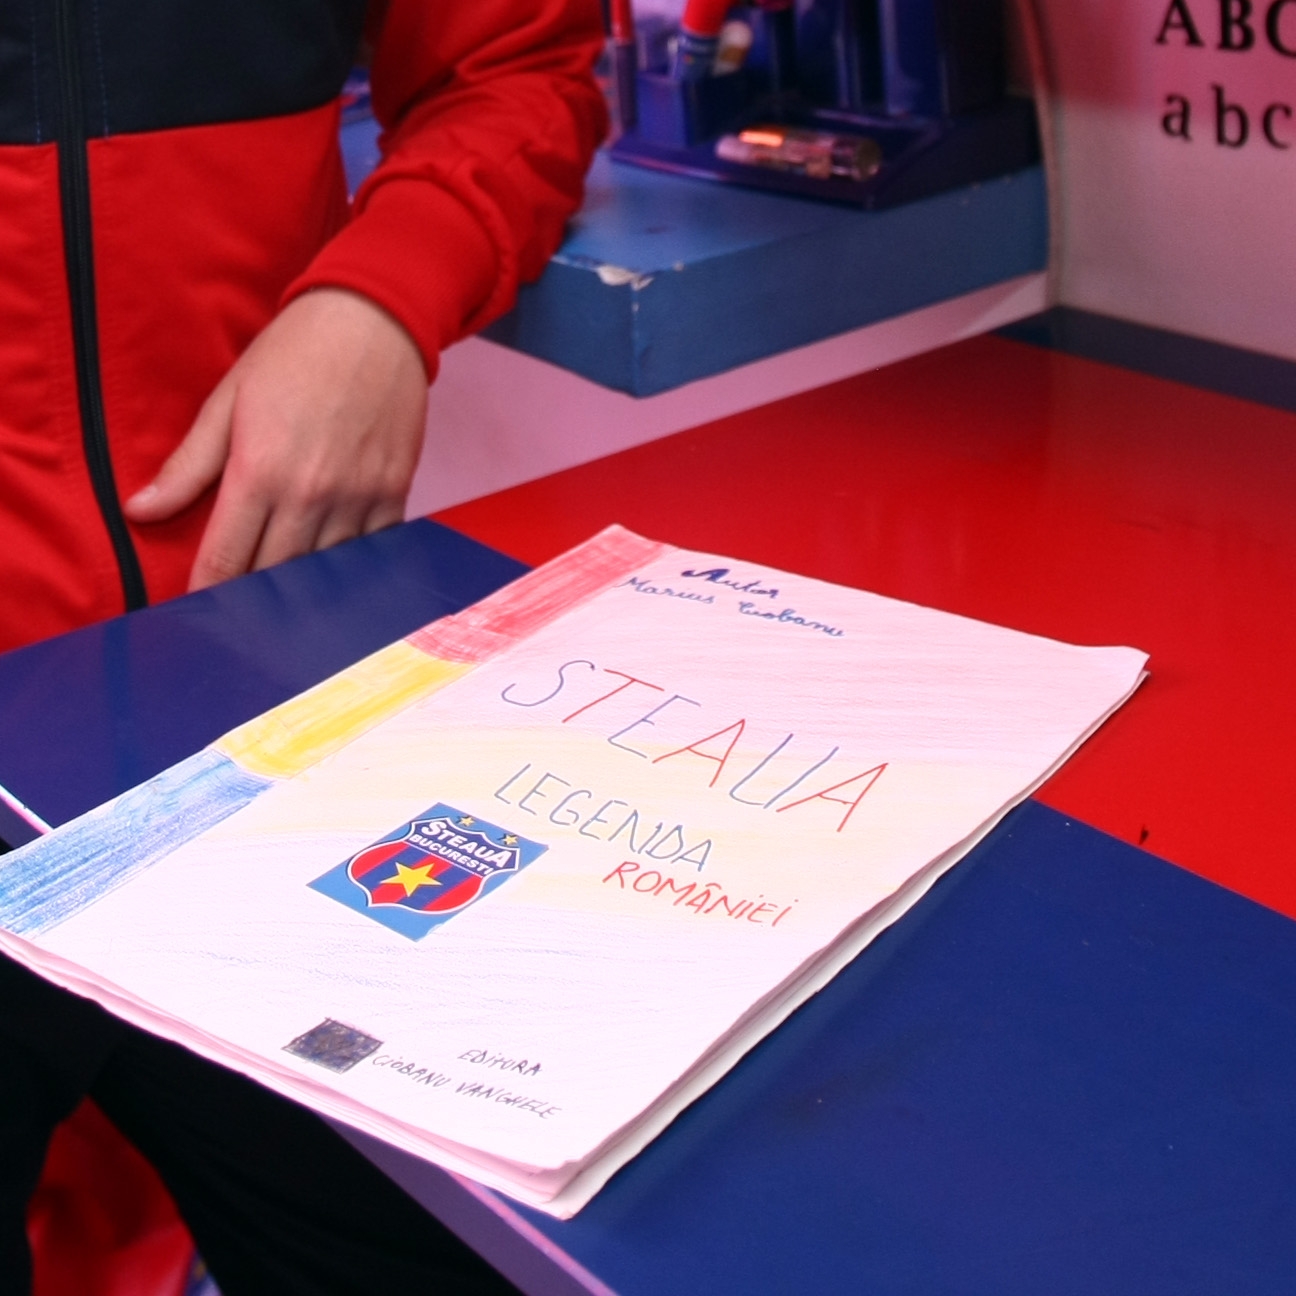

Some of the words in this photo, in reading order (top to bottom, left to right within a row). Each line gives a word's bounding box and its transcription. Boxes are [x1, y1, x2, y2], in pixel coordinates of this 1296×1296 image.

[501, 659, 890, 833] STEAUA
[408, 833, 494, 876] BUCURESTI
[421, 819, 513, 869] STEAUA
[494, 763, 713, 873] LEGENDA
